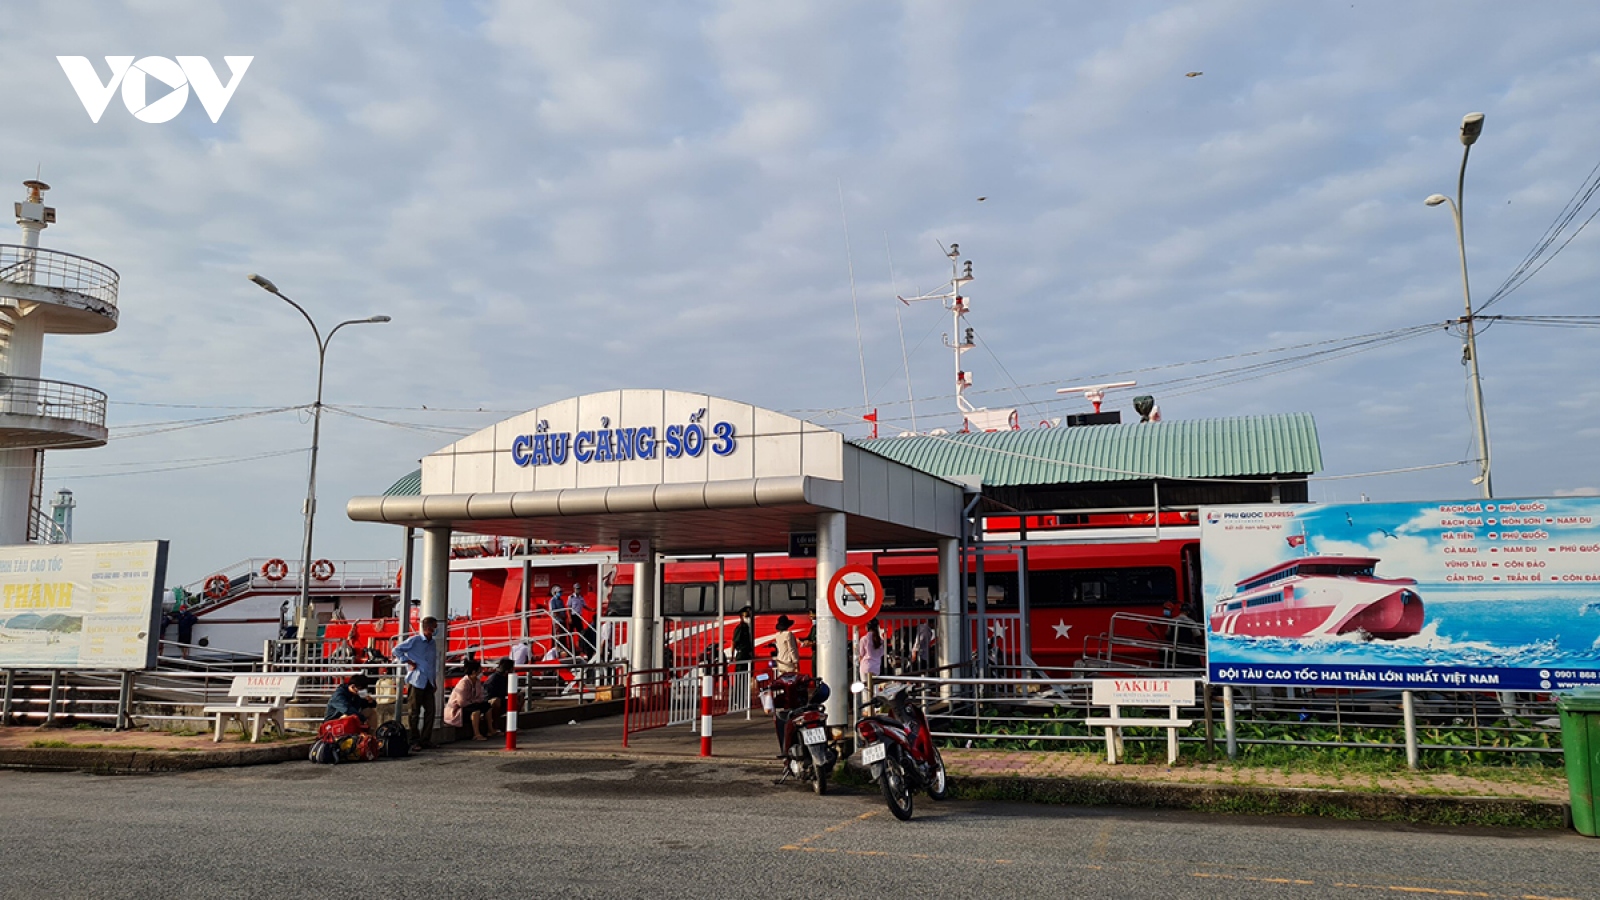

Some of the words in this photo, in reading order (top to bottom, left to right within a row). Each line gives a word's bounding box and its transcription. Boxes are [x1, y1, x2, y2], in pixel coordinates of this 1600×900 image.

[511, 419, 571, 467] CẦU
[573, 416, 657, 464] CẢNG
[665, 407, 706, 458] SỐ
[712, 421, 736, 456] 3
[1519, 500, 1545, 511] QUỐC
[1264, 510, 1295, 518] EXPRESS
[1579, 516, 1592, 524] DU
[1521, 529, 1548, 539] QUỐC
[1579, 542, 1600, 552] QUỐ
[30, 559, 46, 573] CAO
[1218, 667, 1239, 681] ĐỘI
[1241, 667, 1263, 679] TÀU
[1265, 669, 1292, 680] CAO
[1294, 667, 1318, 681] TỐC
[1320, 671, 1342, 681] HAI
[1343, 669, 1377, 681] THÂN
[1379, 669, 1403, 682] LỚN
[1406, 669, 1439, 683] NHẤT
[1441, 671, 1467, 686] VIỆT
[1469, 674, 1500, 684] NAM
[1554, 670, 1577, 679] 0901
[247, 676, 285, 686] YAKULT
[1114, 680, 1171, 692] YAKULT
